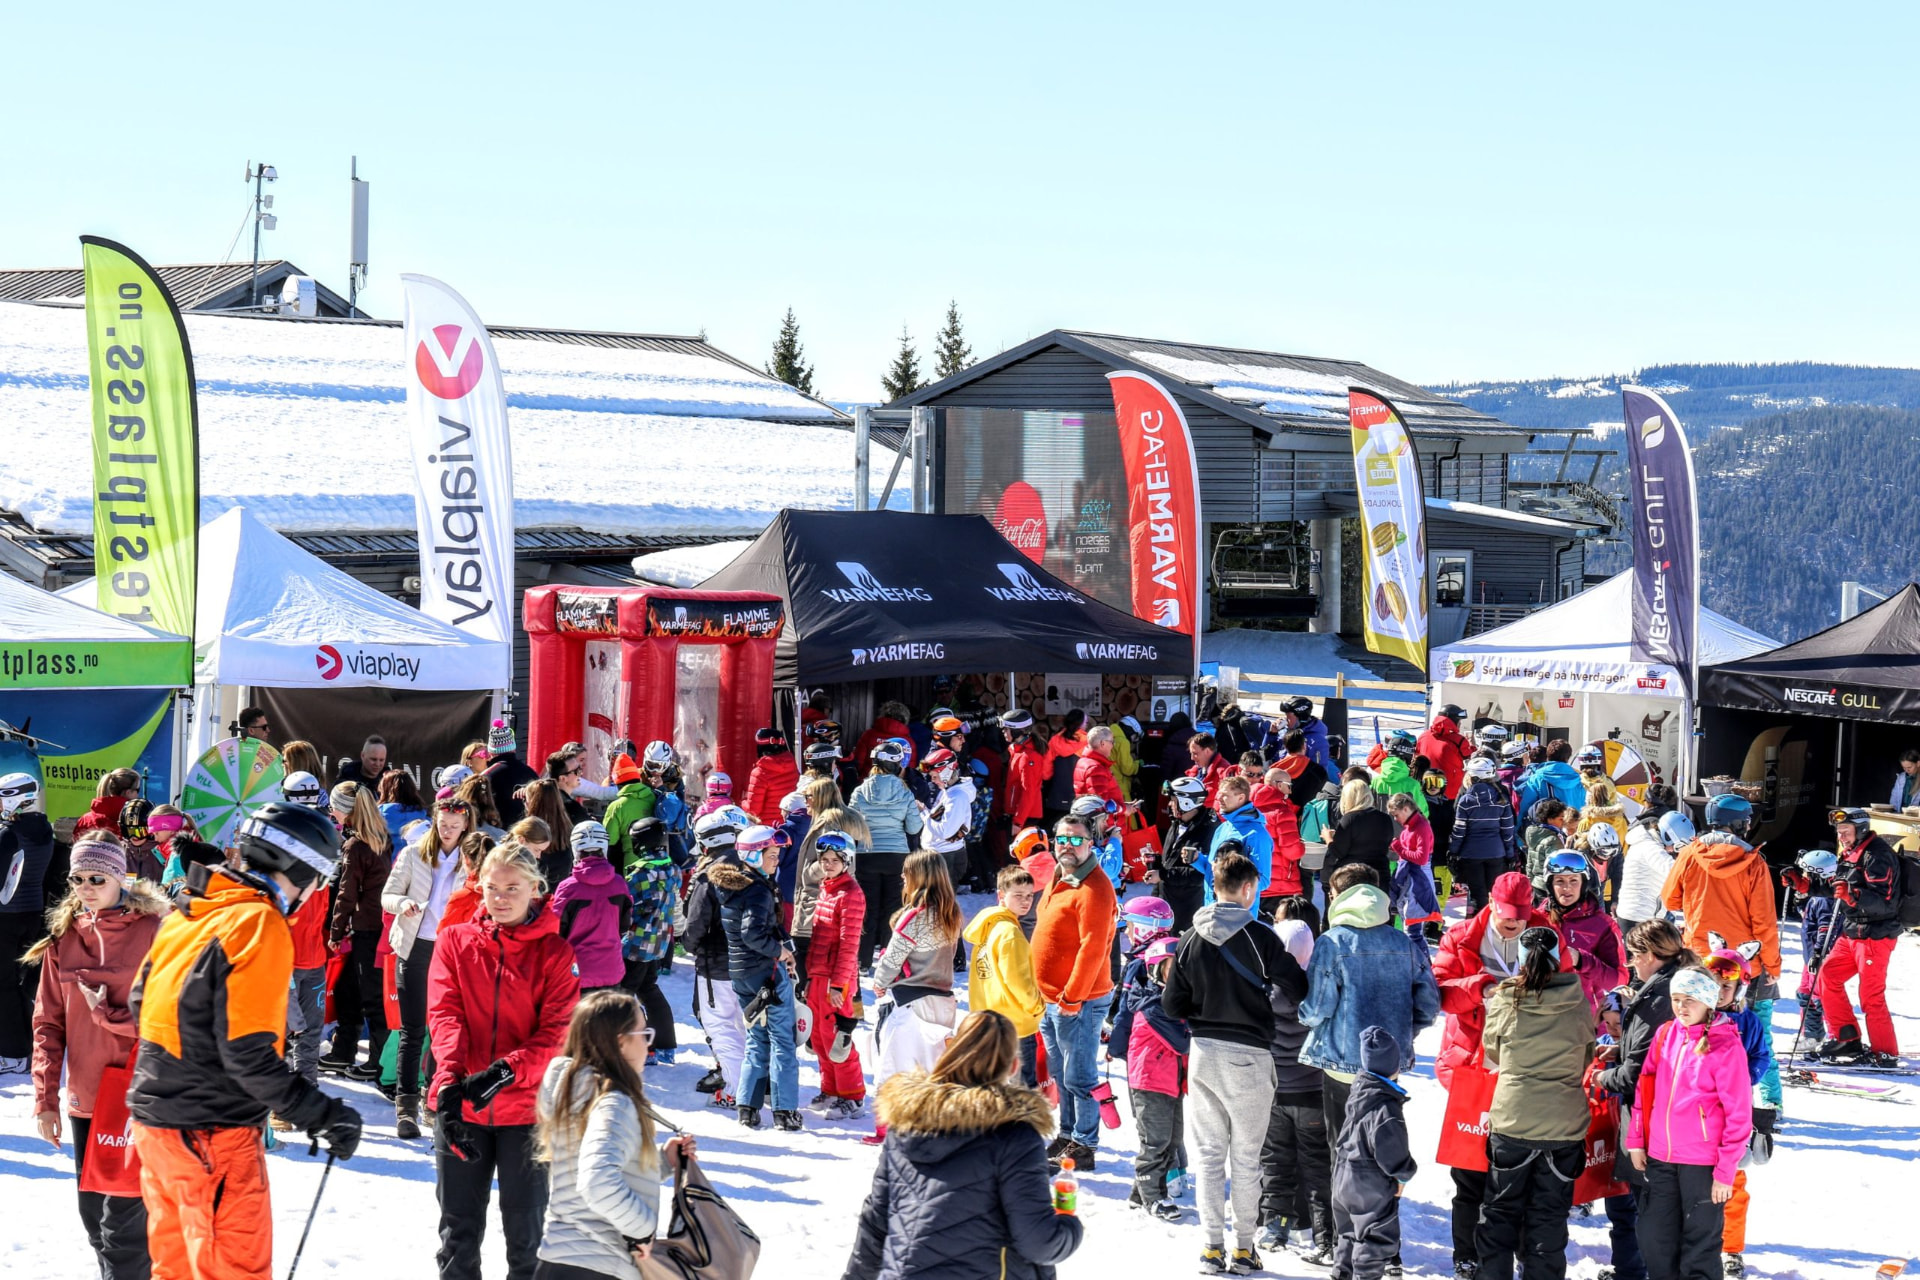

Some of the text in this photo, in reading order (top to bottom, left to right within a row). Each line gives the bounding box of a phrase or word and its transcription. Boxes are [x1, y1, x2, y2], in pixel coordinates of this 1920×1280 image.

[821, 587, 932, 603] VARMEFAG
[984, 587, 1085, 604] VARMEFAG
[556, 607, 592, 623] FLAMME
[723, 607, 770, 626] FLAMME
[660, 620, 702, 630] VARMEFAG
[746, 620, 778, 633] fanger
[868, 643, 944, 663] VARMEFAG
[1089, 643, 1157, 660] VARMEFAG
[3, 649, 98, 681] tplass.no
[347, 650, 420, 682] viaplay
[1482, 666, 1502, 676] Sett
[1505, 667, 1520, 676] litt
[1523, 668, 1551, 680] farge
[1554, 670, 1567, 680] på
[1639, 679, 1663, 688] TINE
[1842, 693, 1881, 709] GULL
[1456, 1121, 1490, 1137] VARM
[1585, 1151, 1616, 1169] ARMEFAG
